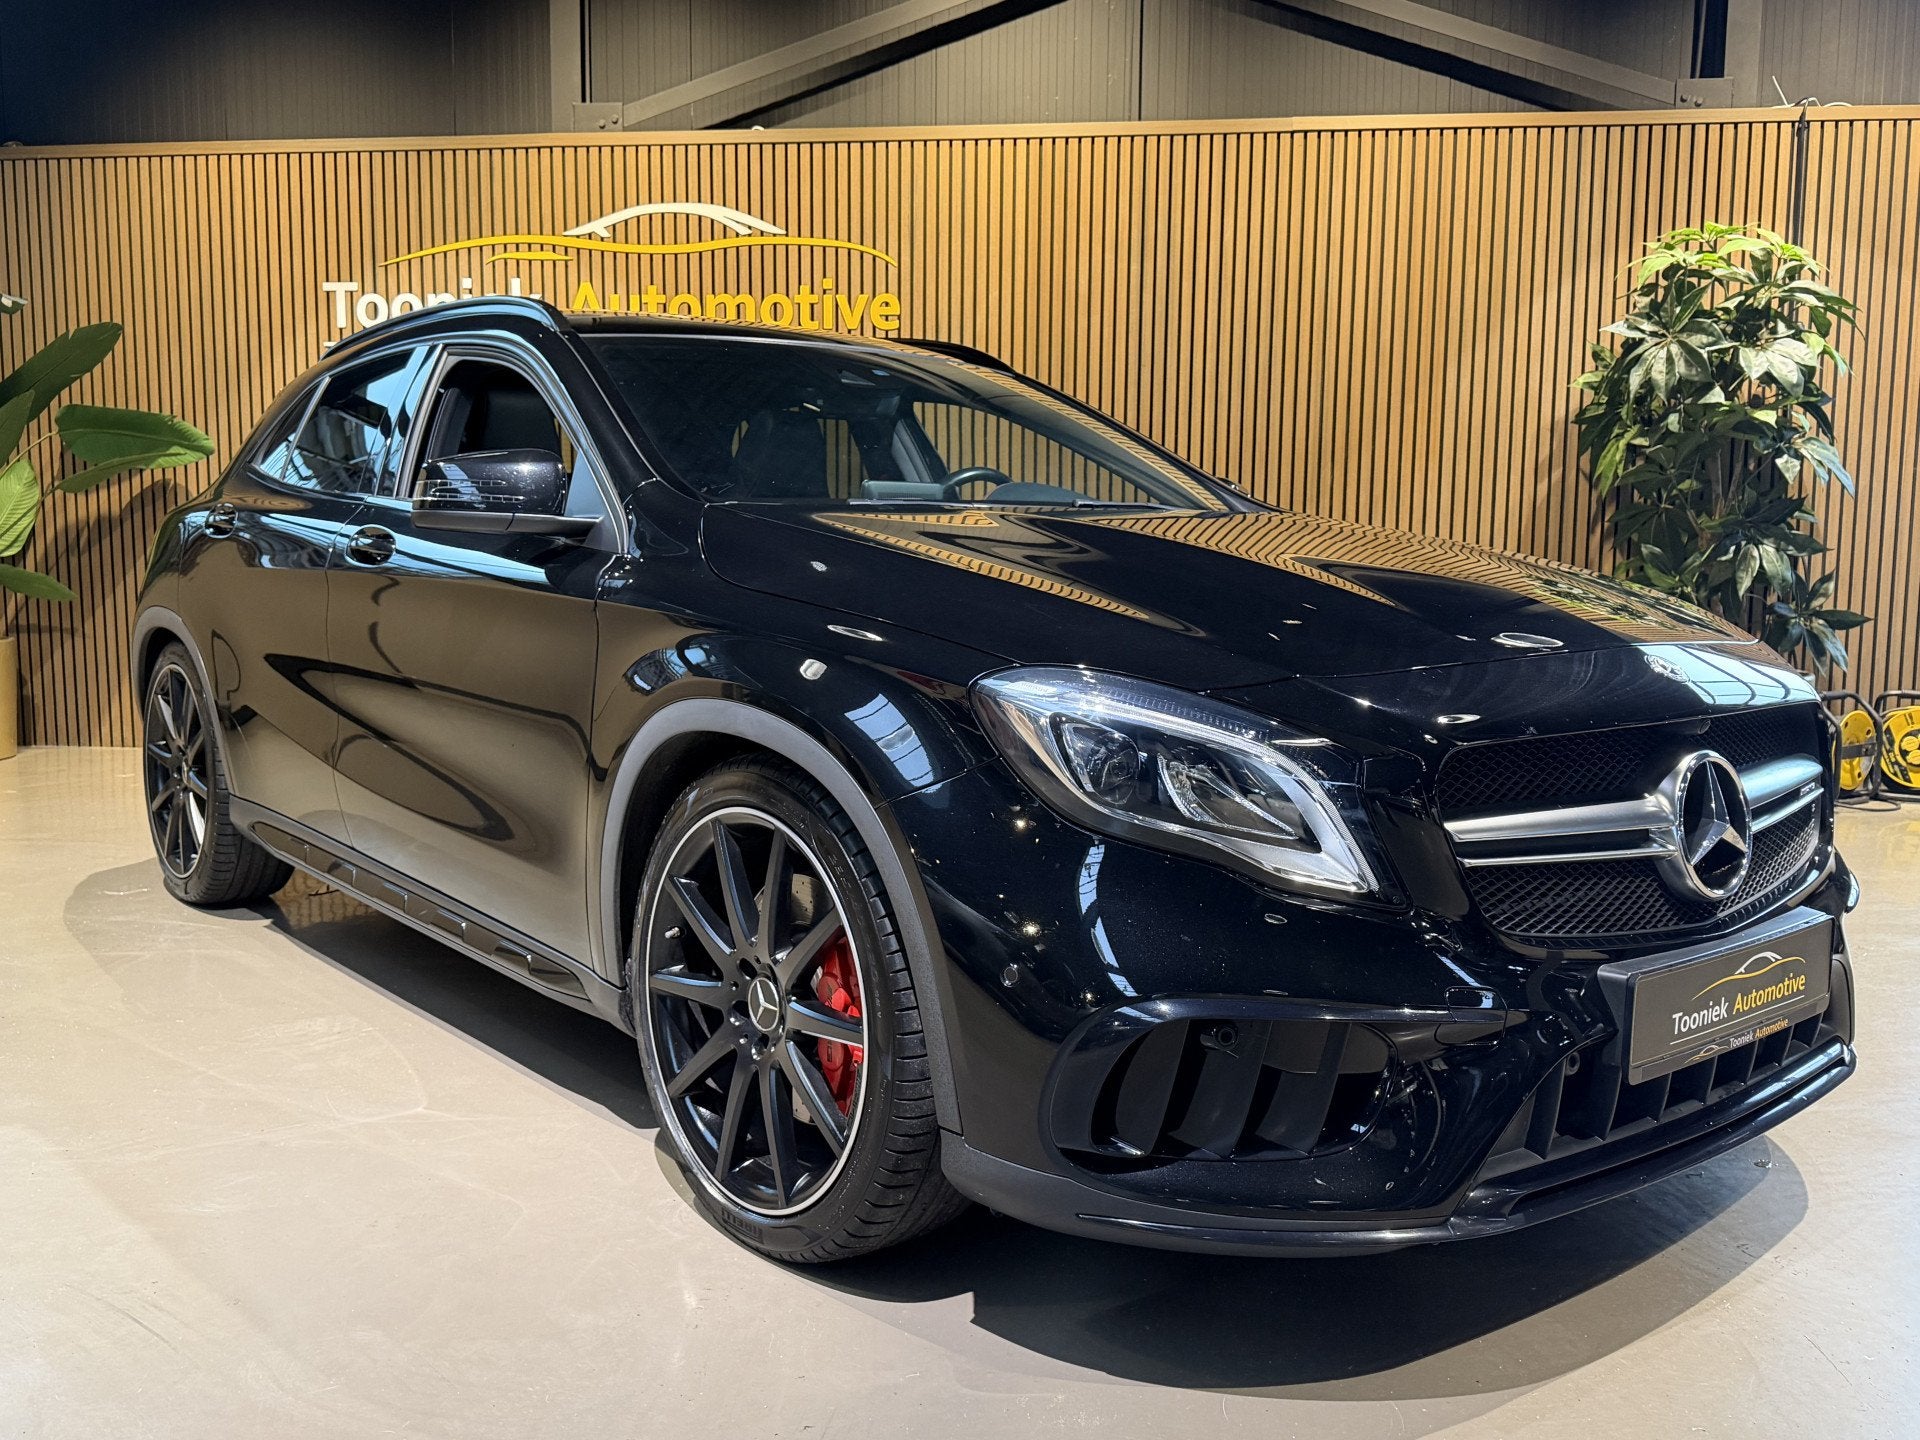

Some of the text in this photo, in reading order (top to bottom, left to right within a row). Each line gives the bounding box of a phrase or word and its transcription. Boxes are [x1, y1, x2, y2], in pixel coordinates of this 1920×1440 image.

[1672, 973, 1806, 1035] Tooniek Automotive
[1729, 1018, 1789, 1049] Tooniek Automotive
